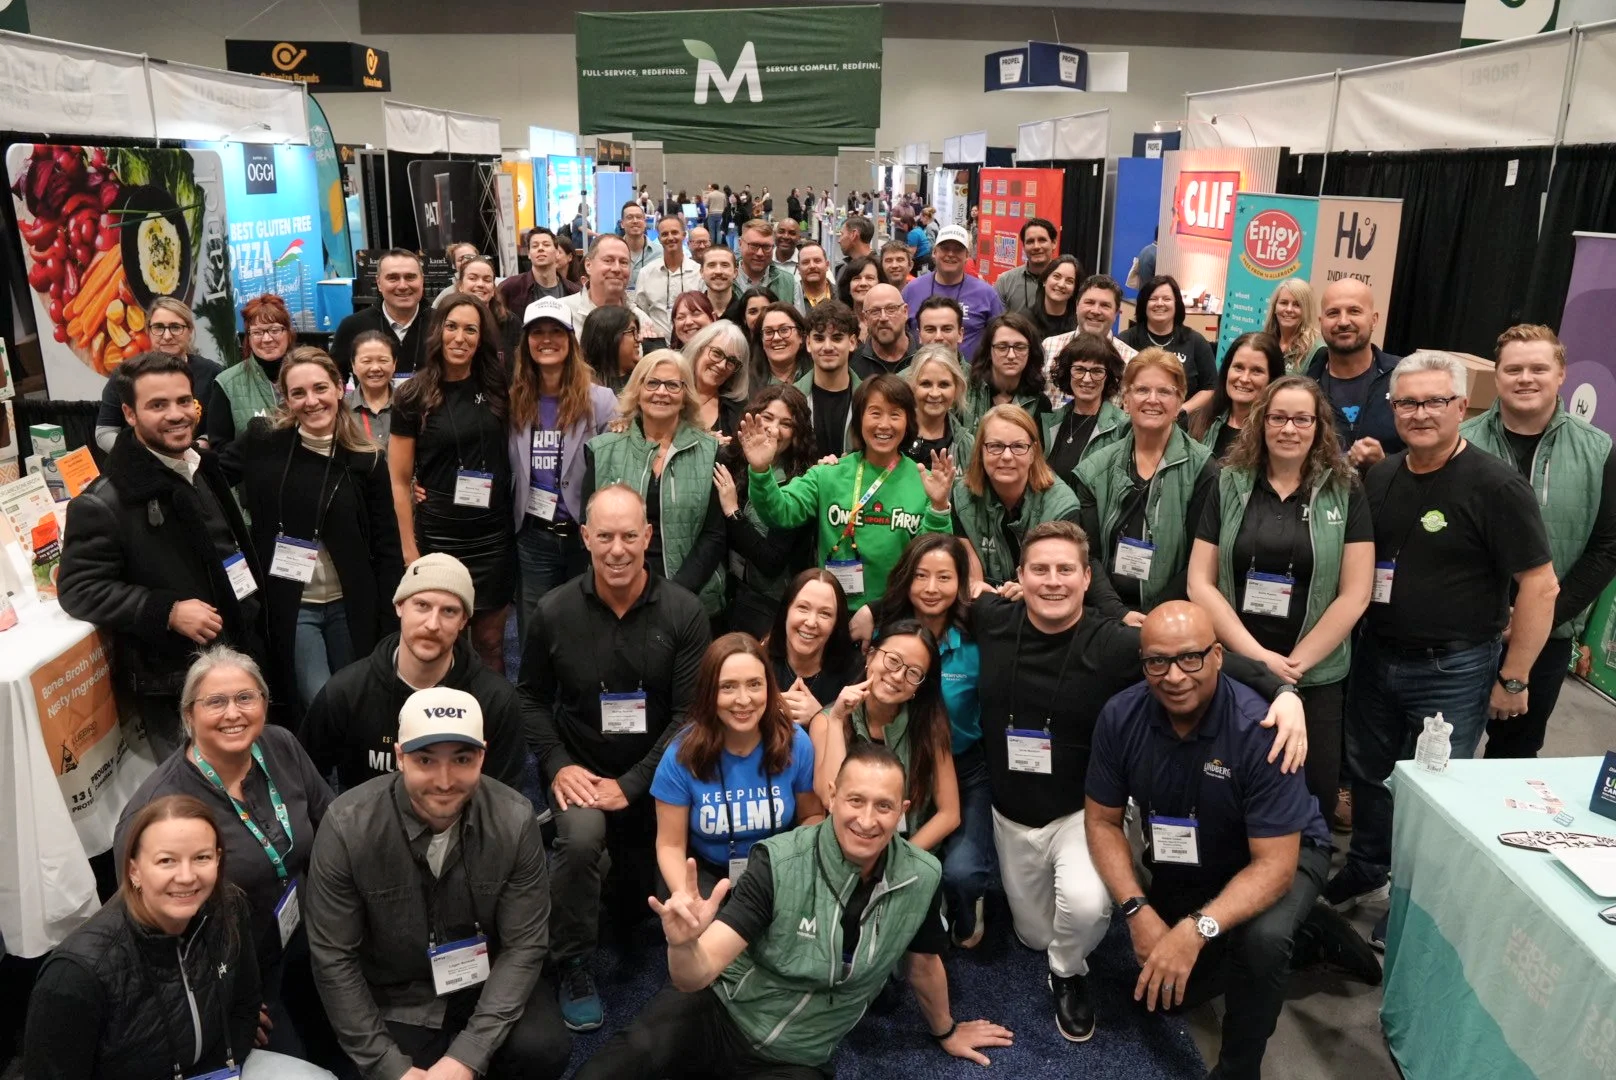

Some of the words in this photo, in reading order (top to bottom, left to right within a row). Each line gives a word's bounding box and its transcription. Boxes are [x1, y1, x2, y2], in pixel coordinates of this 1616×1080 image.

[582, 68, 639, 78] FULL-SERVICE,
[642, 68, 688, 77] REDEFINED.
[765, 64, 799, 73] SERVICE
[799, 63, 840, 73] COMPLET,
[842, 61, 881, 71] REDÉFINI.
[1001, 57, 1020, 66] PROPEL
[247, 163, 275, 182] OGGI
[1183, 180, 1234, 230] CLIF
[230, 222, 255, 242] BEST
[255, 218, 291, 238] GLUTEN
[292, 215, 312, 234] FREE
[1249, 219, 1300, 249] Enjoy
[228, 240, 274, 280] PIZZA
[1256, 238, 1288, 261] Life
[1250, 267, 1264, 277] FROM
[891, 507, 920, 535] FARM
[41, 677, 65, 700] Bone
[65, 658, 89, 683] Broth
[47, 691, 71, 719] Nasty
[71, 663, 111, 699] Ingredien
[423, 707, 467, 719] veer
[702, 785, 781, 804] KEEPING
[700, 797, 785, 835] CALM?
